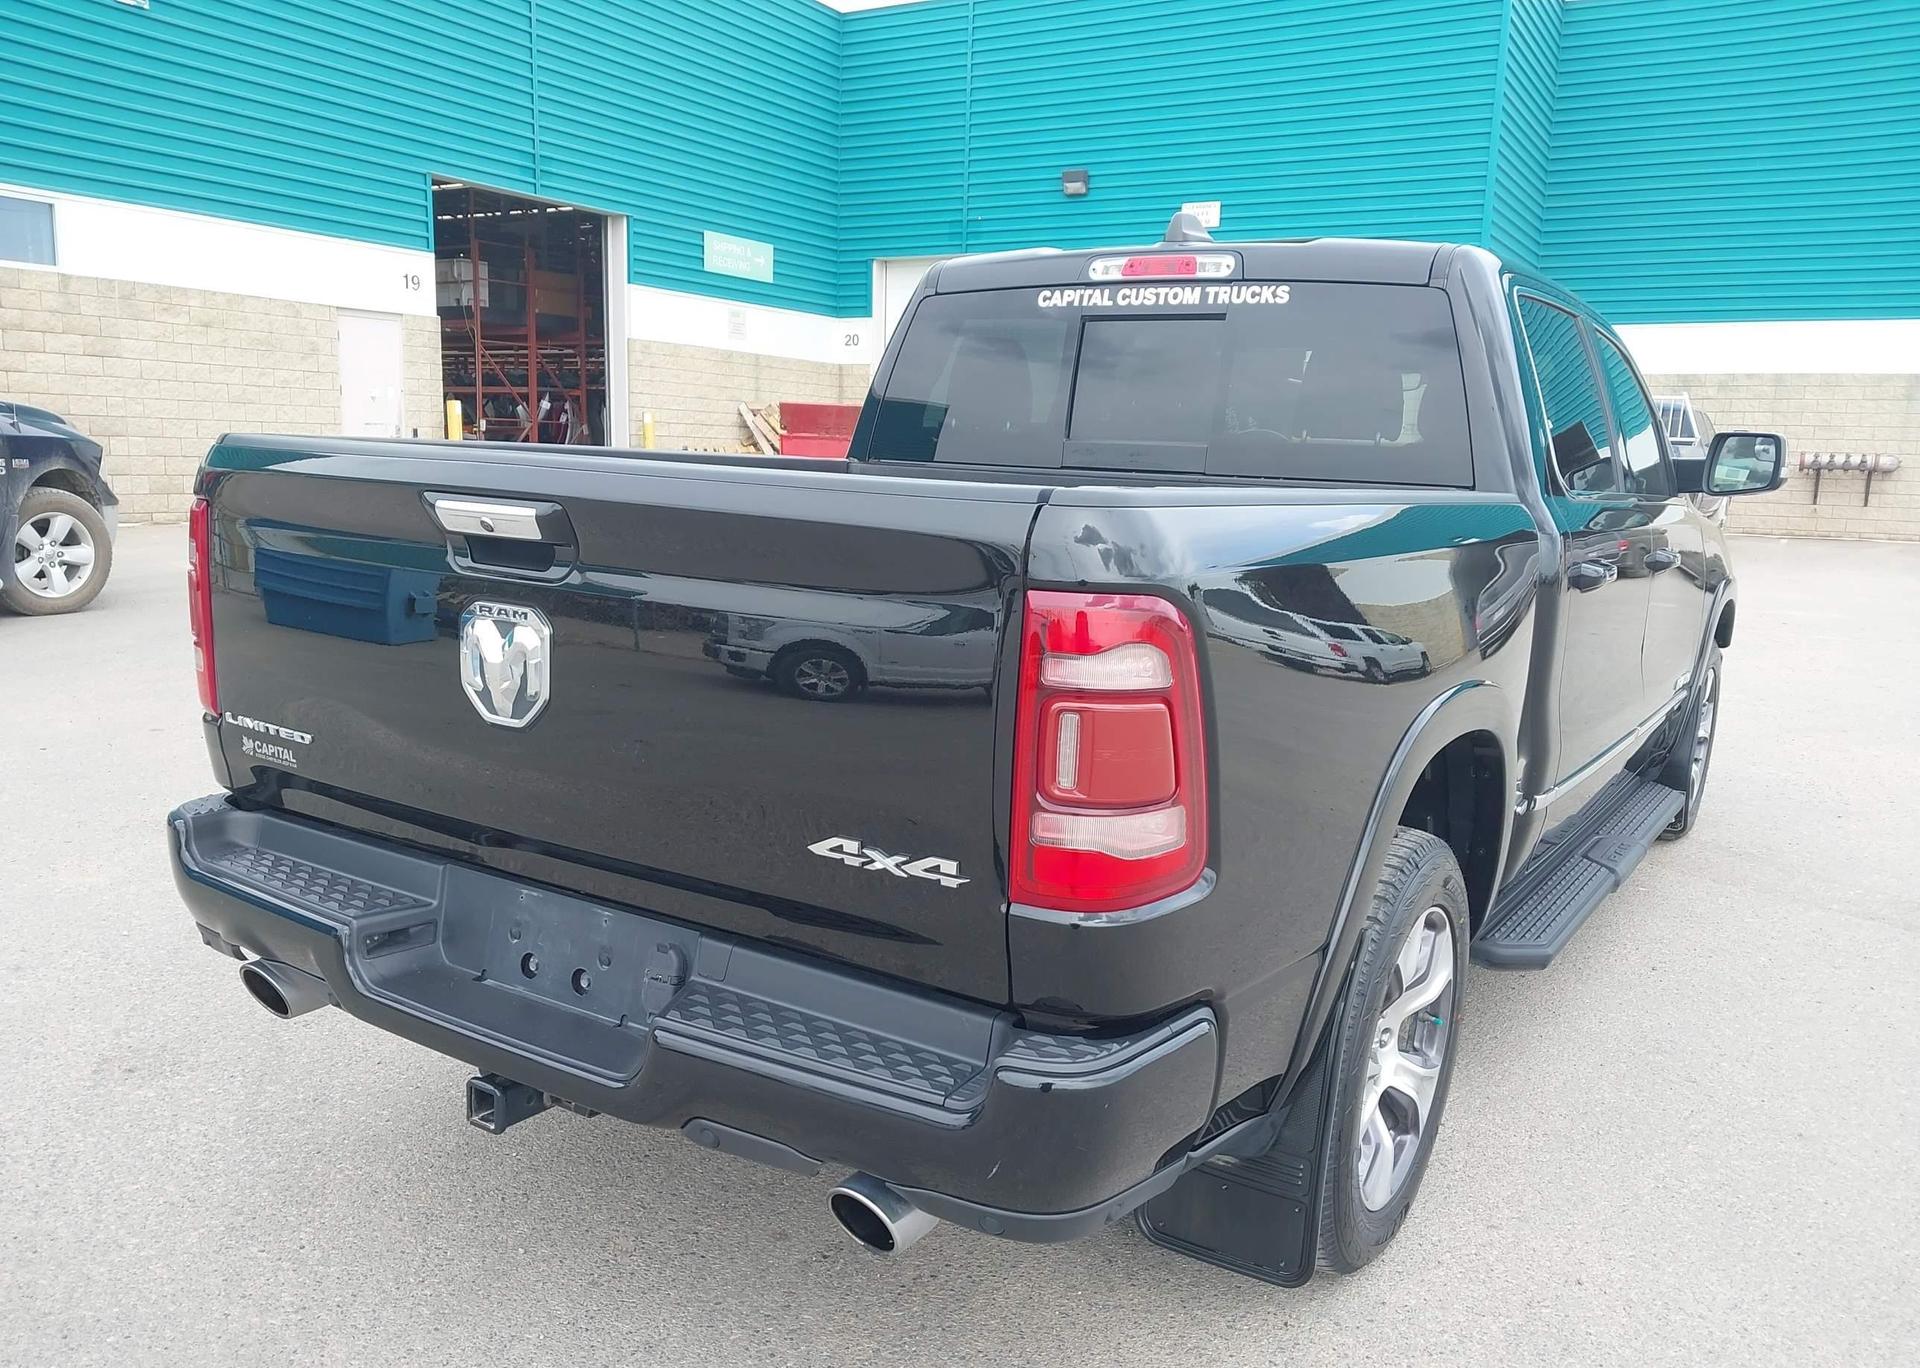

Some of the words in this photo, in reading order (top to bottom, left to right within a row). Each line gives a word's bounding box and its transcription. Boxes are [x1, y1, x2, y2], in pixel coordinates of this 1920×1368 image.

[402, 273, 420, 291] 19
[1037, 287, 1114, 308] CAPITAL
[1116, 286, 1201, 306] CUSTOM
[1205, 284, 1291, 305] TRUCKS
[844, 333, 860, 347] 20
[477, 604, 529, 621] RAM
[224, 711, 313, 745] LIMITED
[254, 740, 297, 763] CAPITAL
